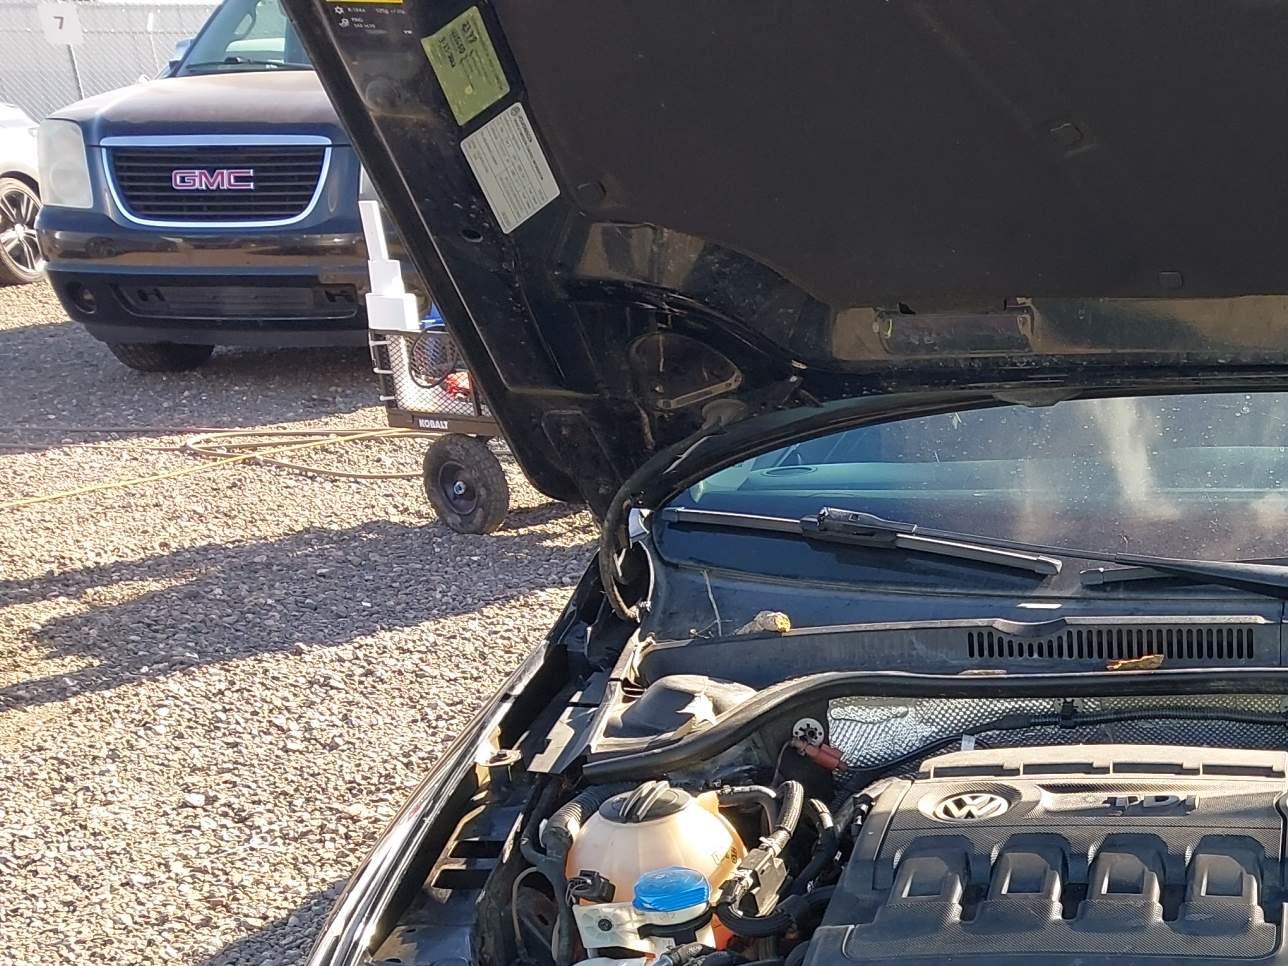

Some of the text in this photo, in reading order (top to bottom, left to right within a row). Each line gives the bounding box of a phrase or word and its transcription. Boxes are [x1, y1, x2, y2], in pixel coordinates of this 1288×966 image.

[53, 16, 65, 30] 7
[172, 168, 254, 190] GMC
[418, 418, 449, 429] KOBALT
[933, 793, 1010, 823] VW
